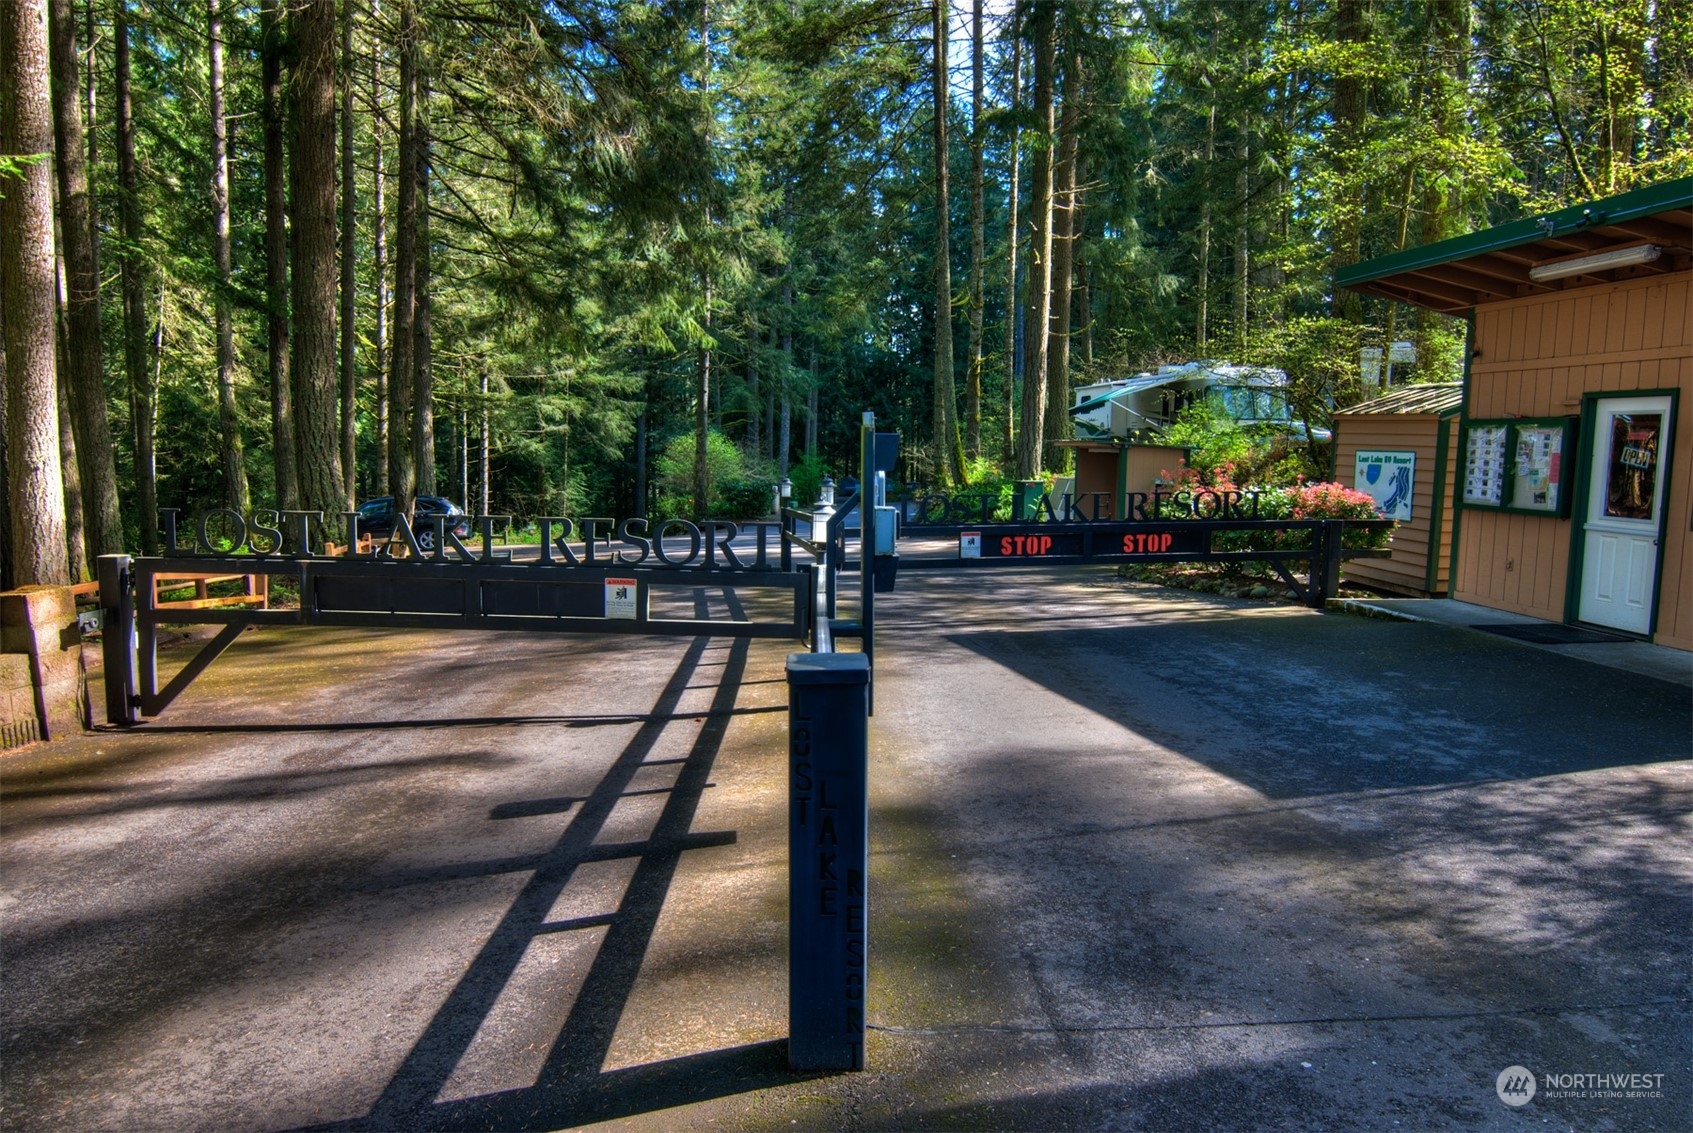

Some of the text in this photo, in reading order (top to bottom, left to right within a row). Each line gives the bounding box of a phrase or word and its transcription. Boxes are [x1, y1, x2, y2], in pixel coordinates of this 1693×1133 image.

[1623, 448, 1648, 466] OPEN
[899, 490, 1268, 525] LOST LAKE RESORT
[158, 507, 783, 569] LOST LAKE RESORT
[1001, 535, 1052, 556] STOP
[1122, 533, 1173, 554] STOP
[794, 691, 813, 826] LOST
[818, 779, 838, 917] LAKE
[846, 868, 864, 1070] RESORT
